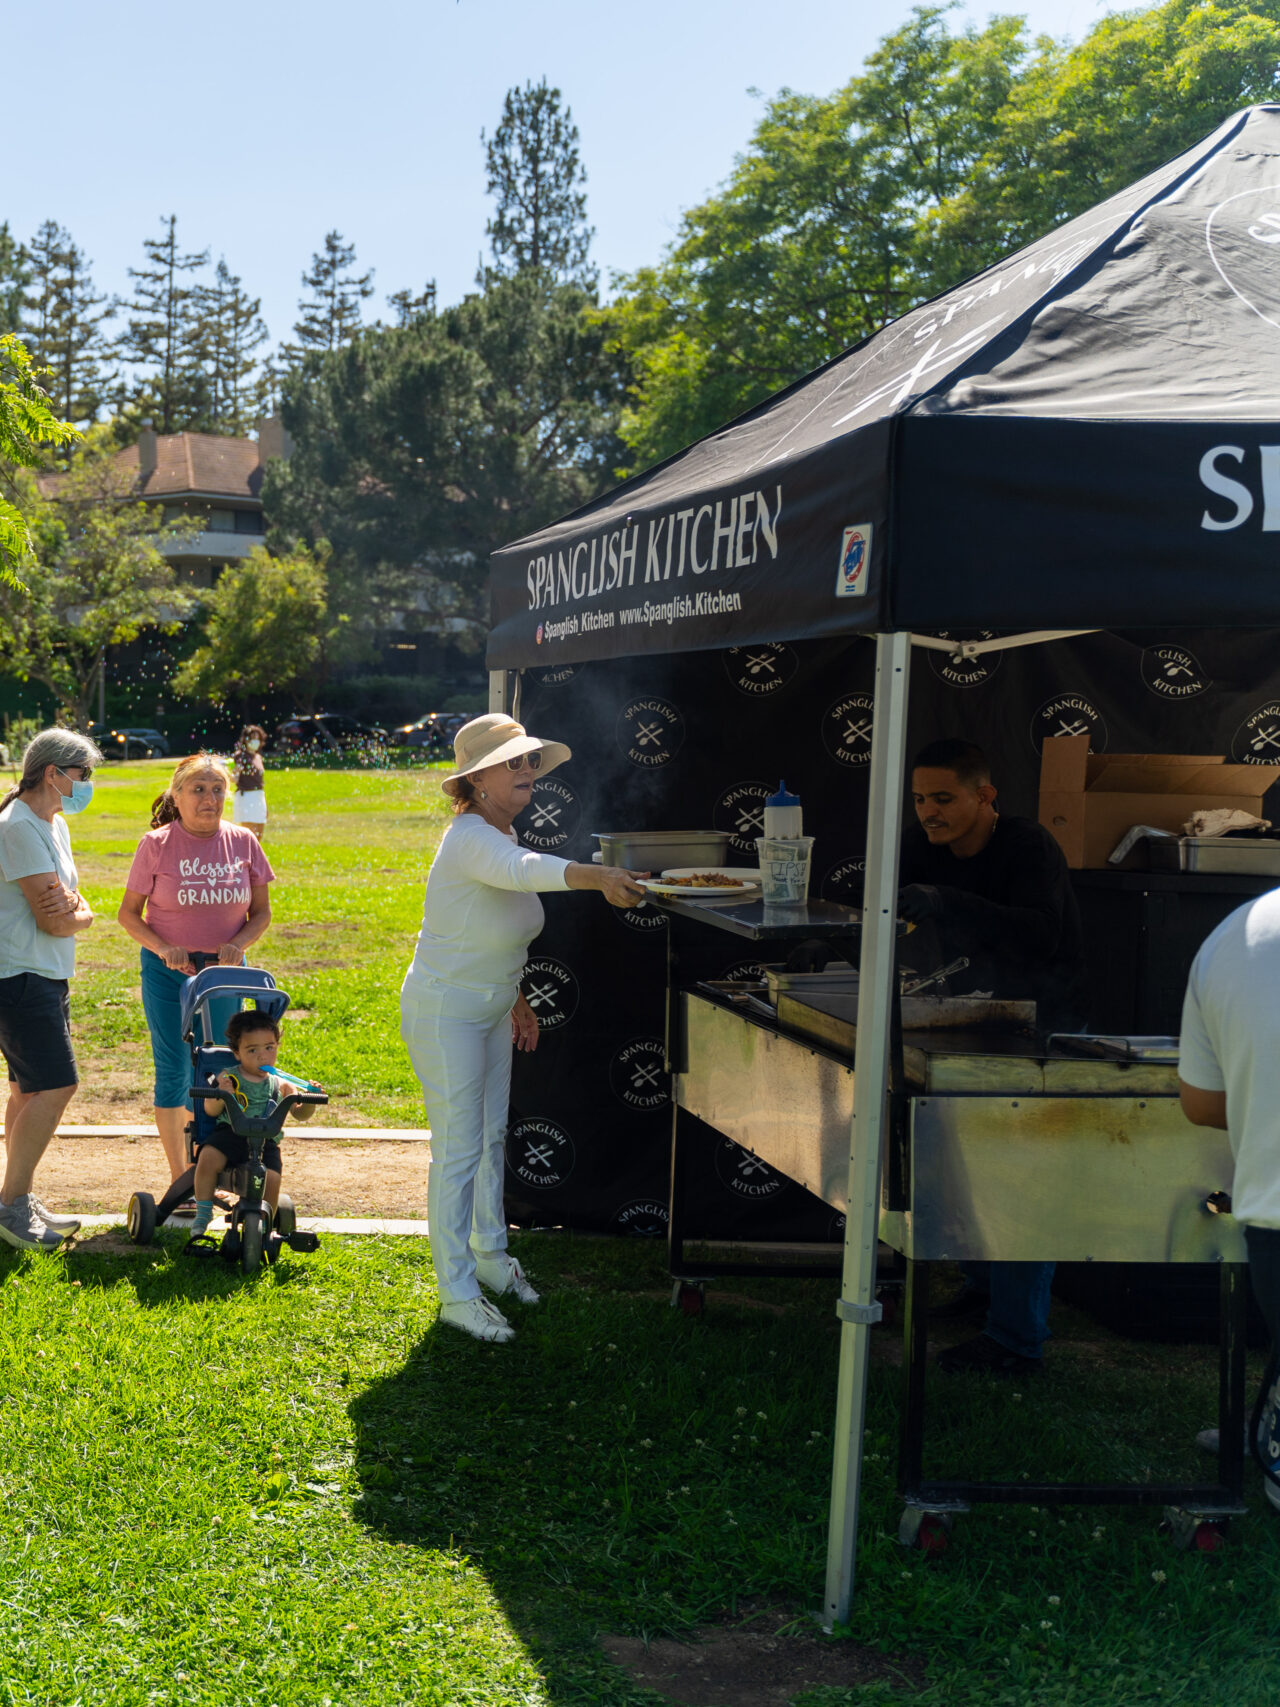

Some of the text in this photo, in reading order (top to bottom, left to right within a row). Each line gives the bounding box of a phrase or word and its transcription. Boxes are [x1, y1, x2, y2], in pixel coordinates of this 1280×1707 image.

[527, 523, 639, 611] SPANGLISH
[644, 484, 783, 584] KITCHEN
[619, 590, 743, 628] www.Spanglish.Kitchen
[738, 676, 783, 692] KITCHEN
[942, 666, 988, 684] KITCHEN
[1152, 678, 1202, 696] KITCHEN
[624, 701, 678, 724] SPANGLISH
[831, 697, 873, 720] SPANGLI
[1042, 698, 1099, 721] SPANGLISH
[628, 748, 671, 765] KITCHEN
[523, 830, 568, 847] KITCHEN
[179, 856, 244, 878] Blessed
[177, 887, 250, 906] GRANDMA
[623, 1089, 669, 1106] KITCHEN
[513, 1122, 567, 1146] SPANGLISH
[517, 1166, 561, 1185] KITCHEN
[730, 1177, 780, 1195] KITCHEN
